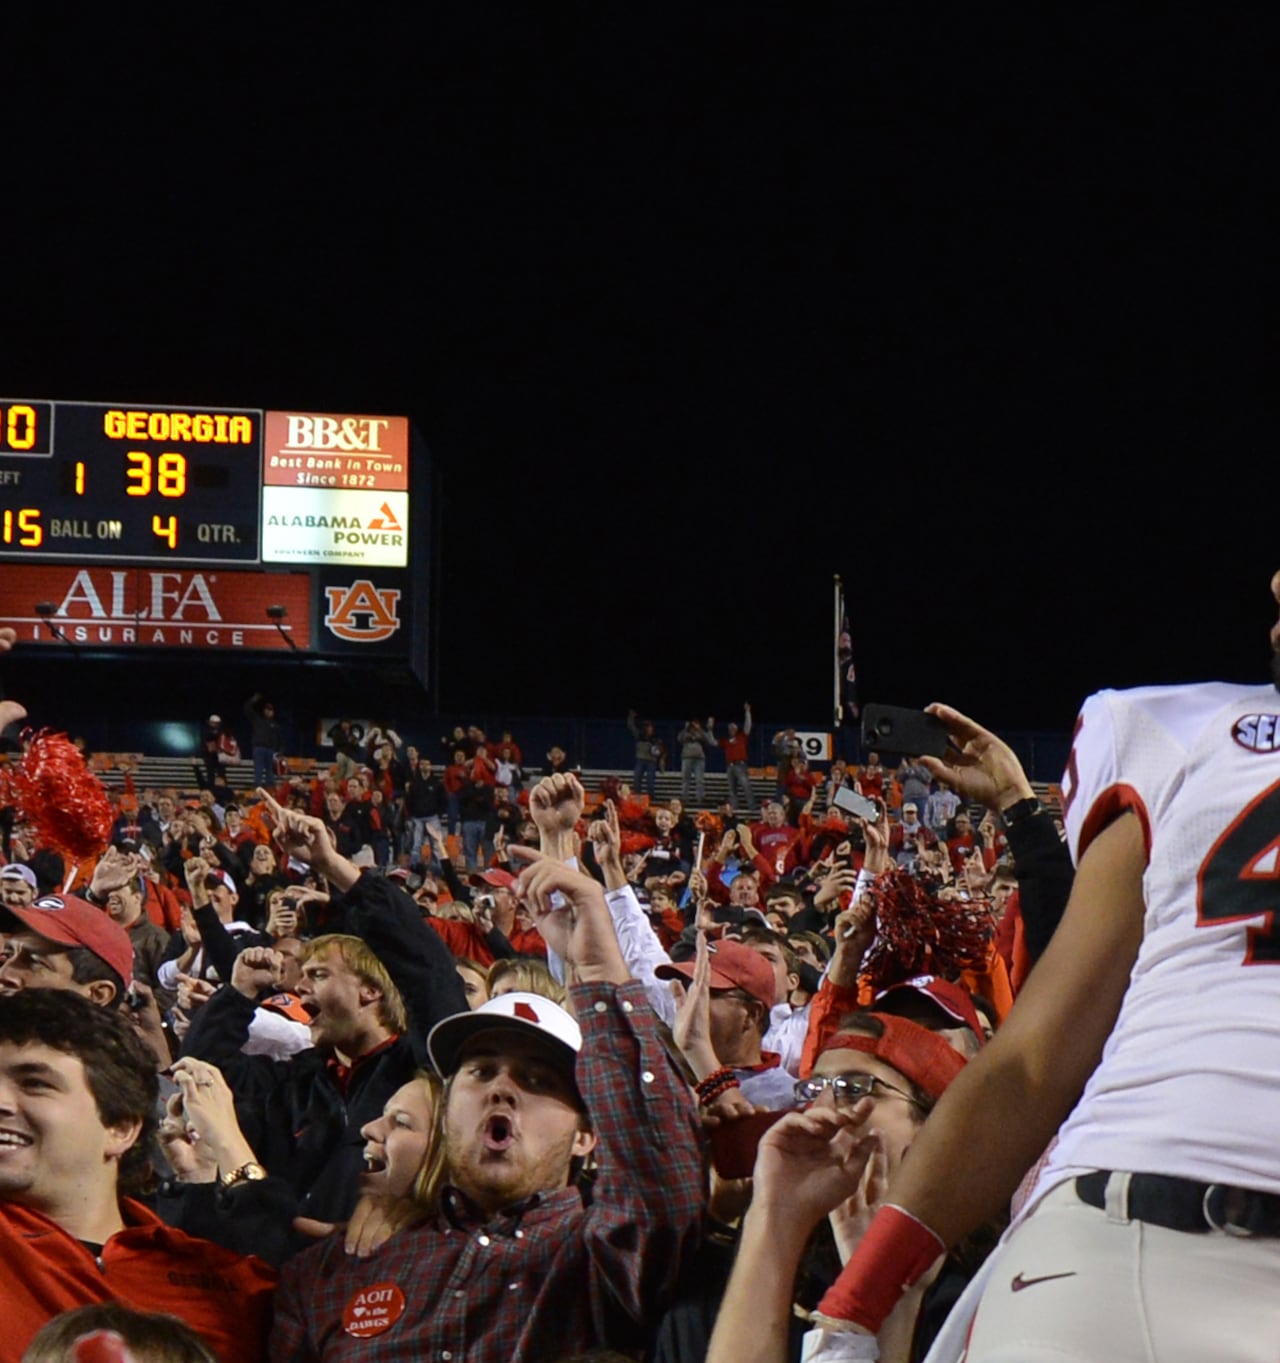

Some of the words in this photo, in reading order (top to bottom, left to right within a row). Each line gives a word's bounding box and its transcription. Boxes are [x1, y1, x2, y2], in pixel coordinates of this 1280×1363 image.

[104, 410, 252, 444] GEORGIA
[285, 415, 389, 451] BB&T
[75, 461, 85, 495] 1
[126, 451, 187, 497] 38
[270, 455, 302, 468] Best
[306, 456, 342, 470] Bank
[366, 460, 403, 473] Town
[296, 472, 337, 485] Since
[342, 474, 376, 487] 1872
[3, 508, 43, 547] 15
[50, 519, 92, 539] BALL
[97, 520, 122, 540] ON
[152, 515, 177, 549] 4
[196, 523, 241, 543] QTR.
[267, 514, 363, 529] ALABAMA
[333, 531, 403, 547] POWER
[56, 569, 222, 622] ALFA
